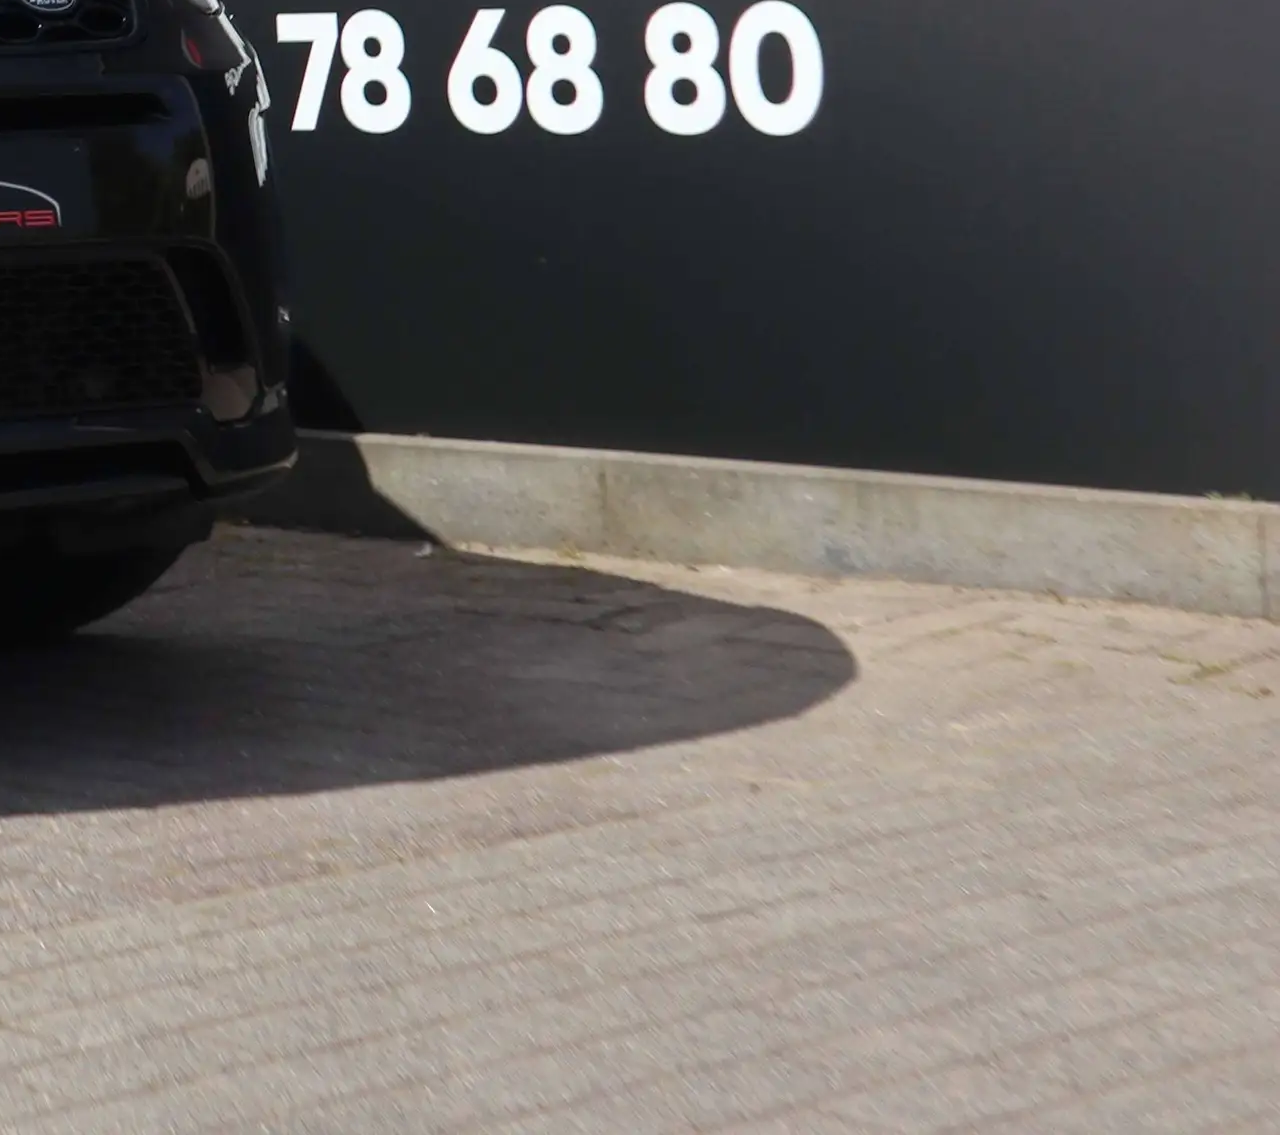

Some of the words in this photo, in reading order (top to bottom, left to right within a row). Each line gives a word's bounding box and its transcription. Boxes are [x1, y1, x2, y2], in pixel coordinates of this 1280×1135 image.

[275, 9, 411, 134] 78
[447, 4, 604, 135] 68
[644, 0, 824, 136] 80
